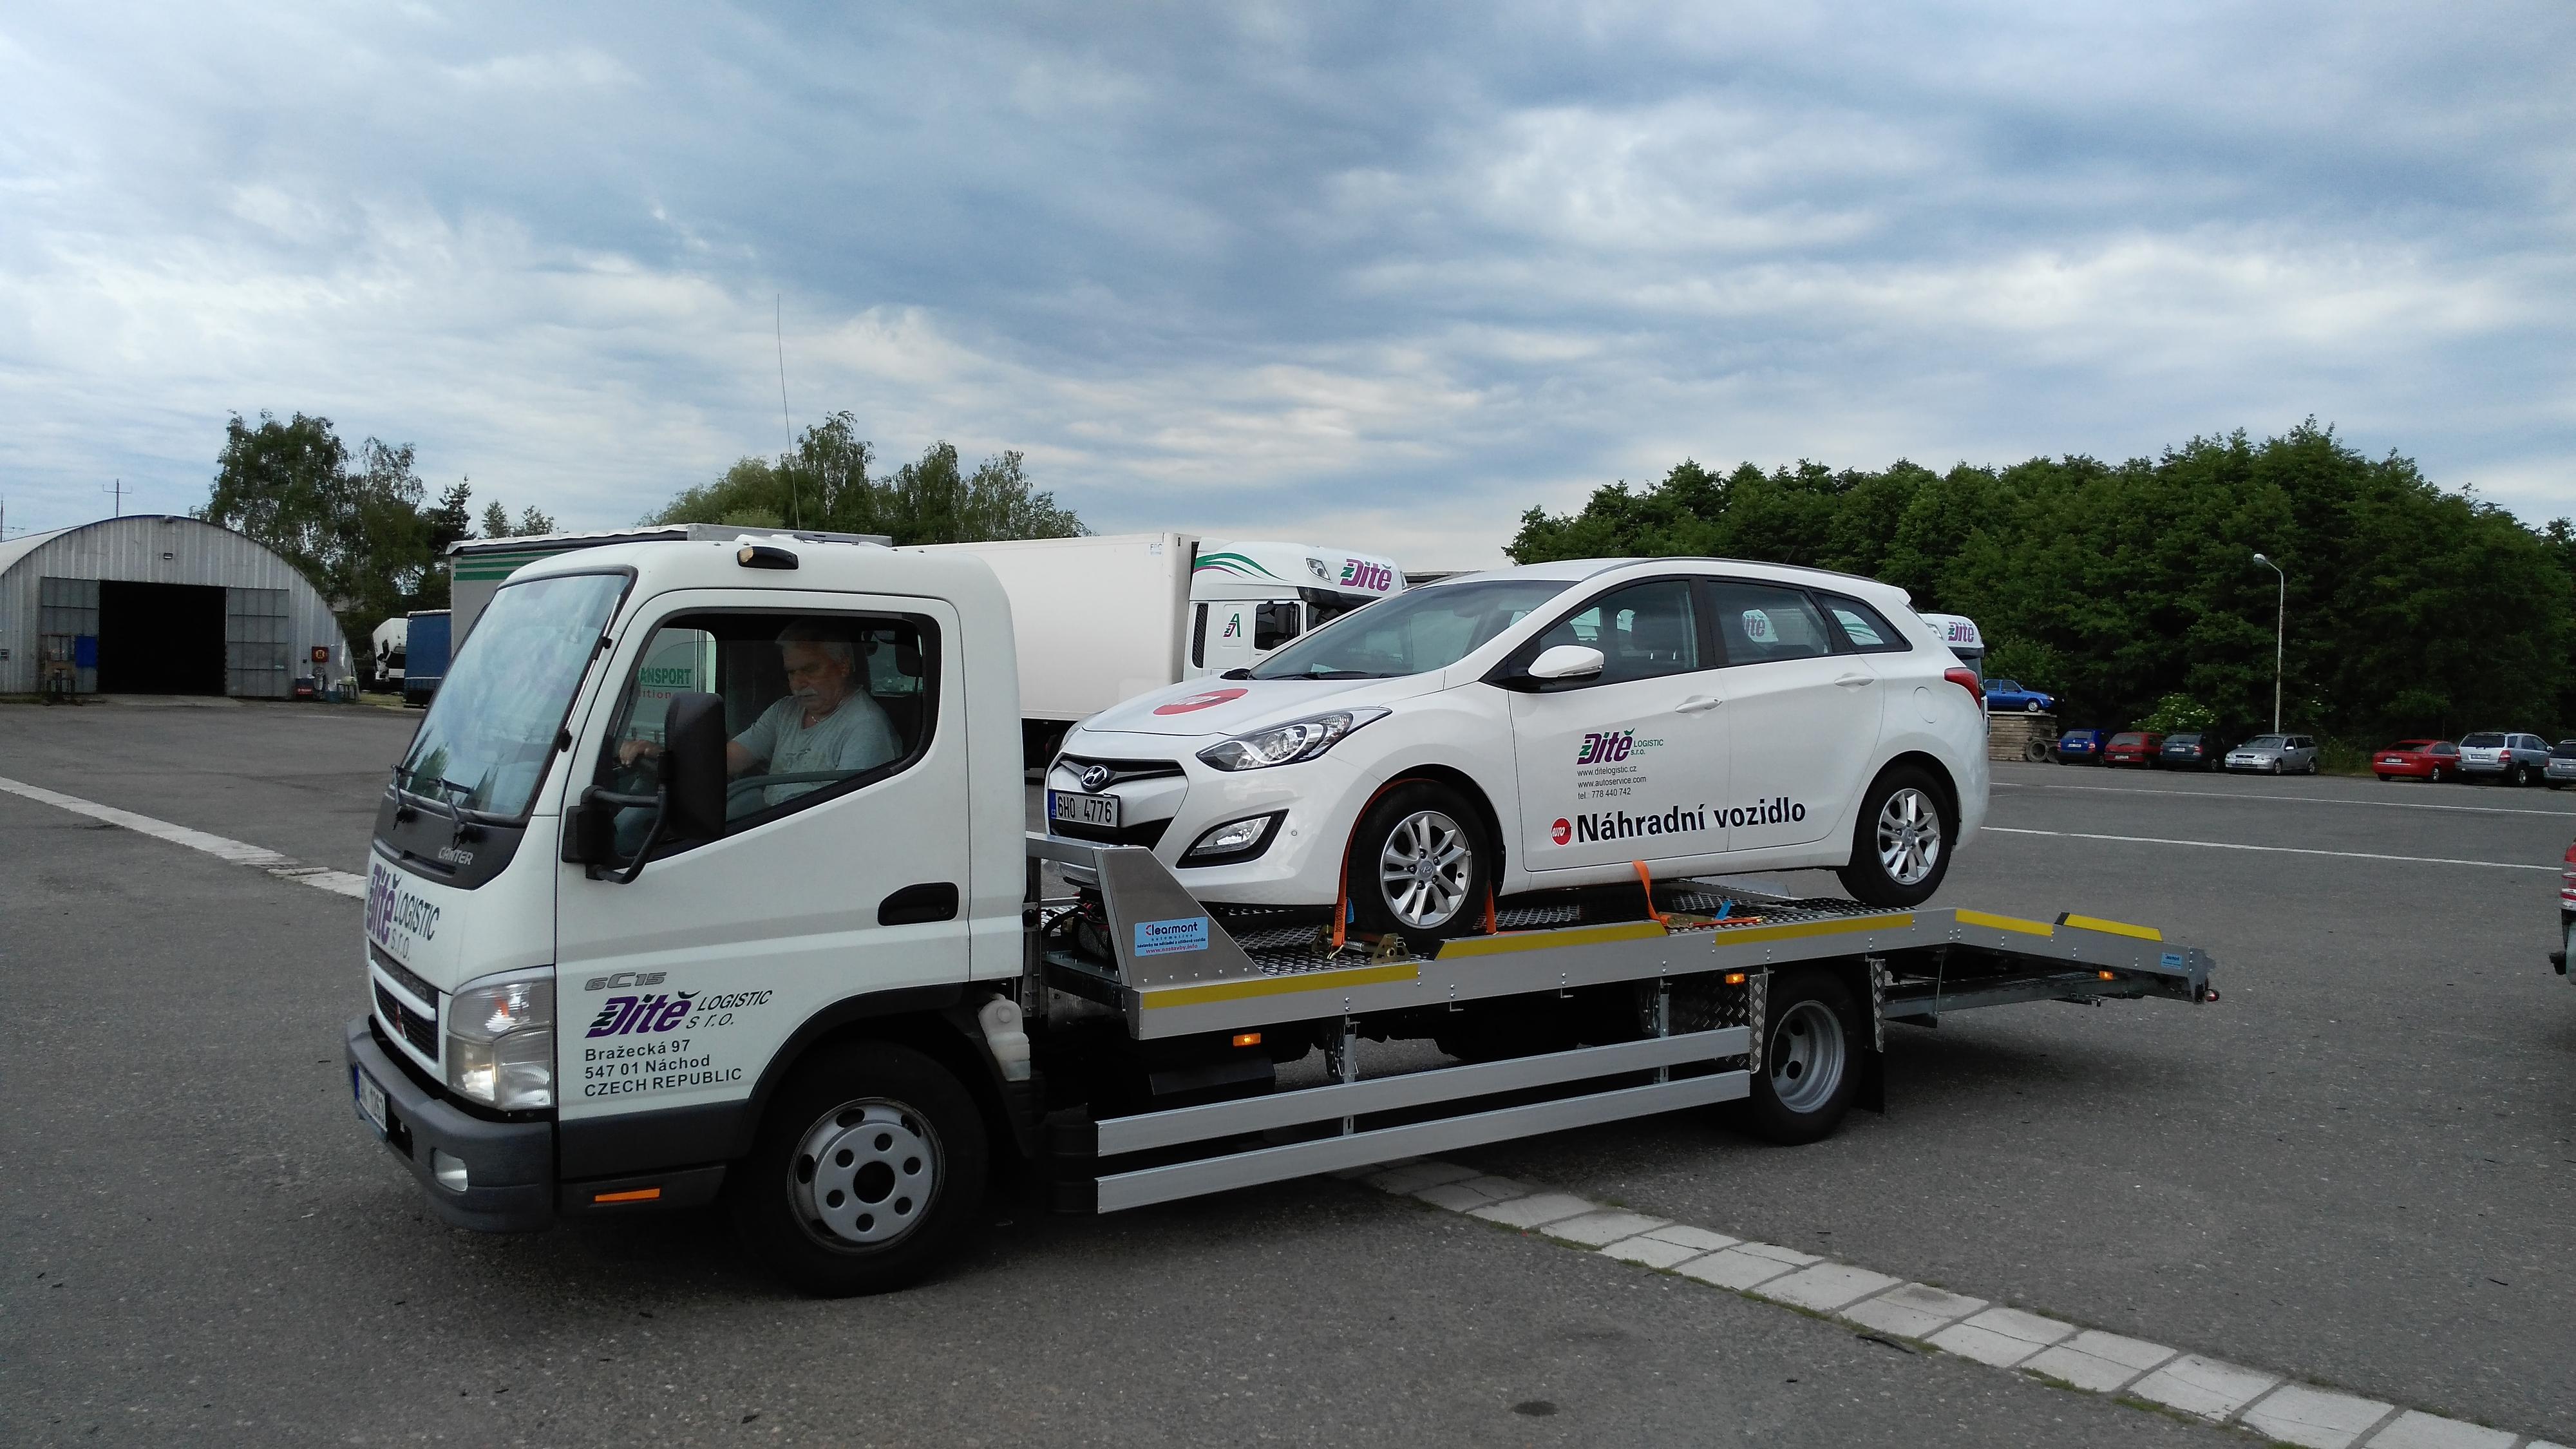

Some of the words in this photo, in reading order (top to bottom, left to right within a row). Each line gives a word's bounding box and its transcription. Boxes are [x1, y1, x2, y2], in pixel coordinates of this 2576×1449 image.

[1633, 739, 1664, 748] LOGISTIC
[1577, 765, 1637, 777] www.ditelogistic.cz
[1577, 776, 1647, 788] www.autoservice.com
[1592, 790, 1604, 799] 778
[1605, 788, 1618, 797] 440
[1619, 787, 1631, 795] 742
[1084, 799, 1112, 823] 4776
[1551, 826, 1566, 837] AUTO
[1577, 803, 1705, 843] Náhradní
[1713, 796, 1805, 829] vozidlo
[438, 846, 474, 866] CANTER
[393, 889, 440, 942] LOGISTIC
[1146, 922, 1198, 936] Clearmont
[390, 928, 411, 961] s.r.o.
[584, 972, 668, 991] 6C15
[696, 990, 773, 1012] LOGISTIC
[585, 1041, 667, 1062] Bražecká
[671, 1039, 691, 1053] 97
[584, 1064, 615, 1079] 547
[620, 1062, 639, 1076] 01
[645, 1054, 711, 1074] Náchod
[584, 1078, 647, 1097] CZECH
[652, 1067, 743, 1090] REPUBLIC
